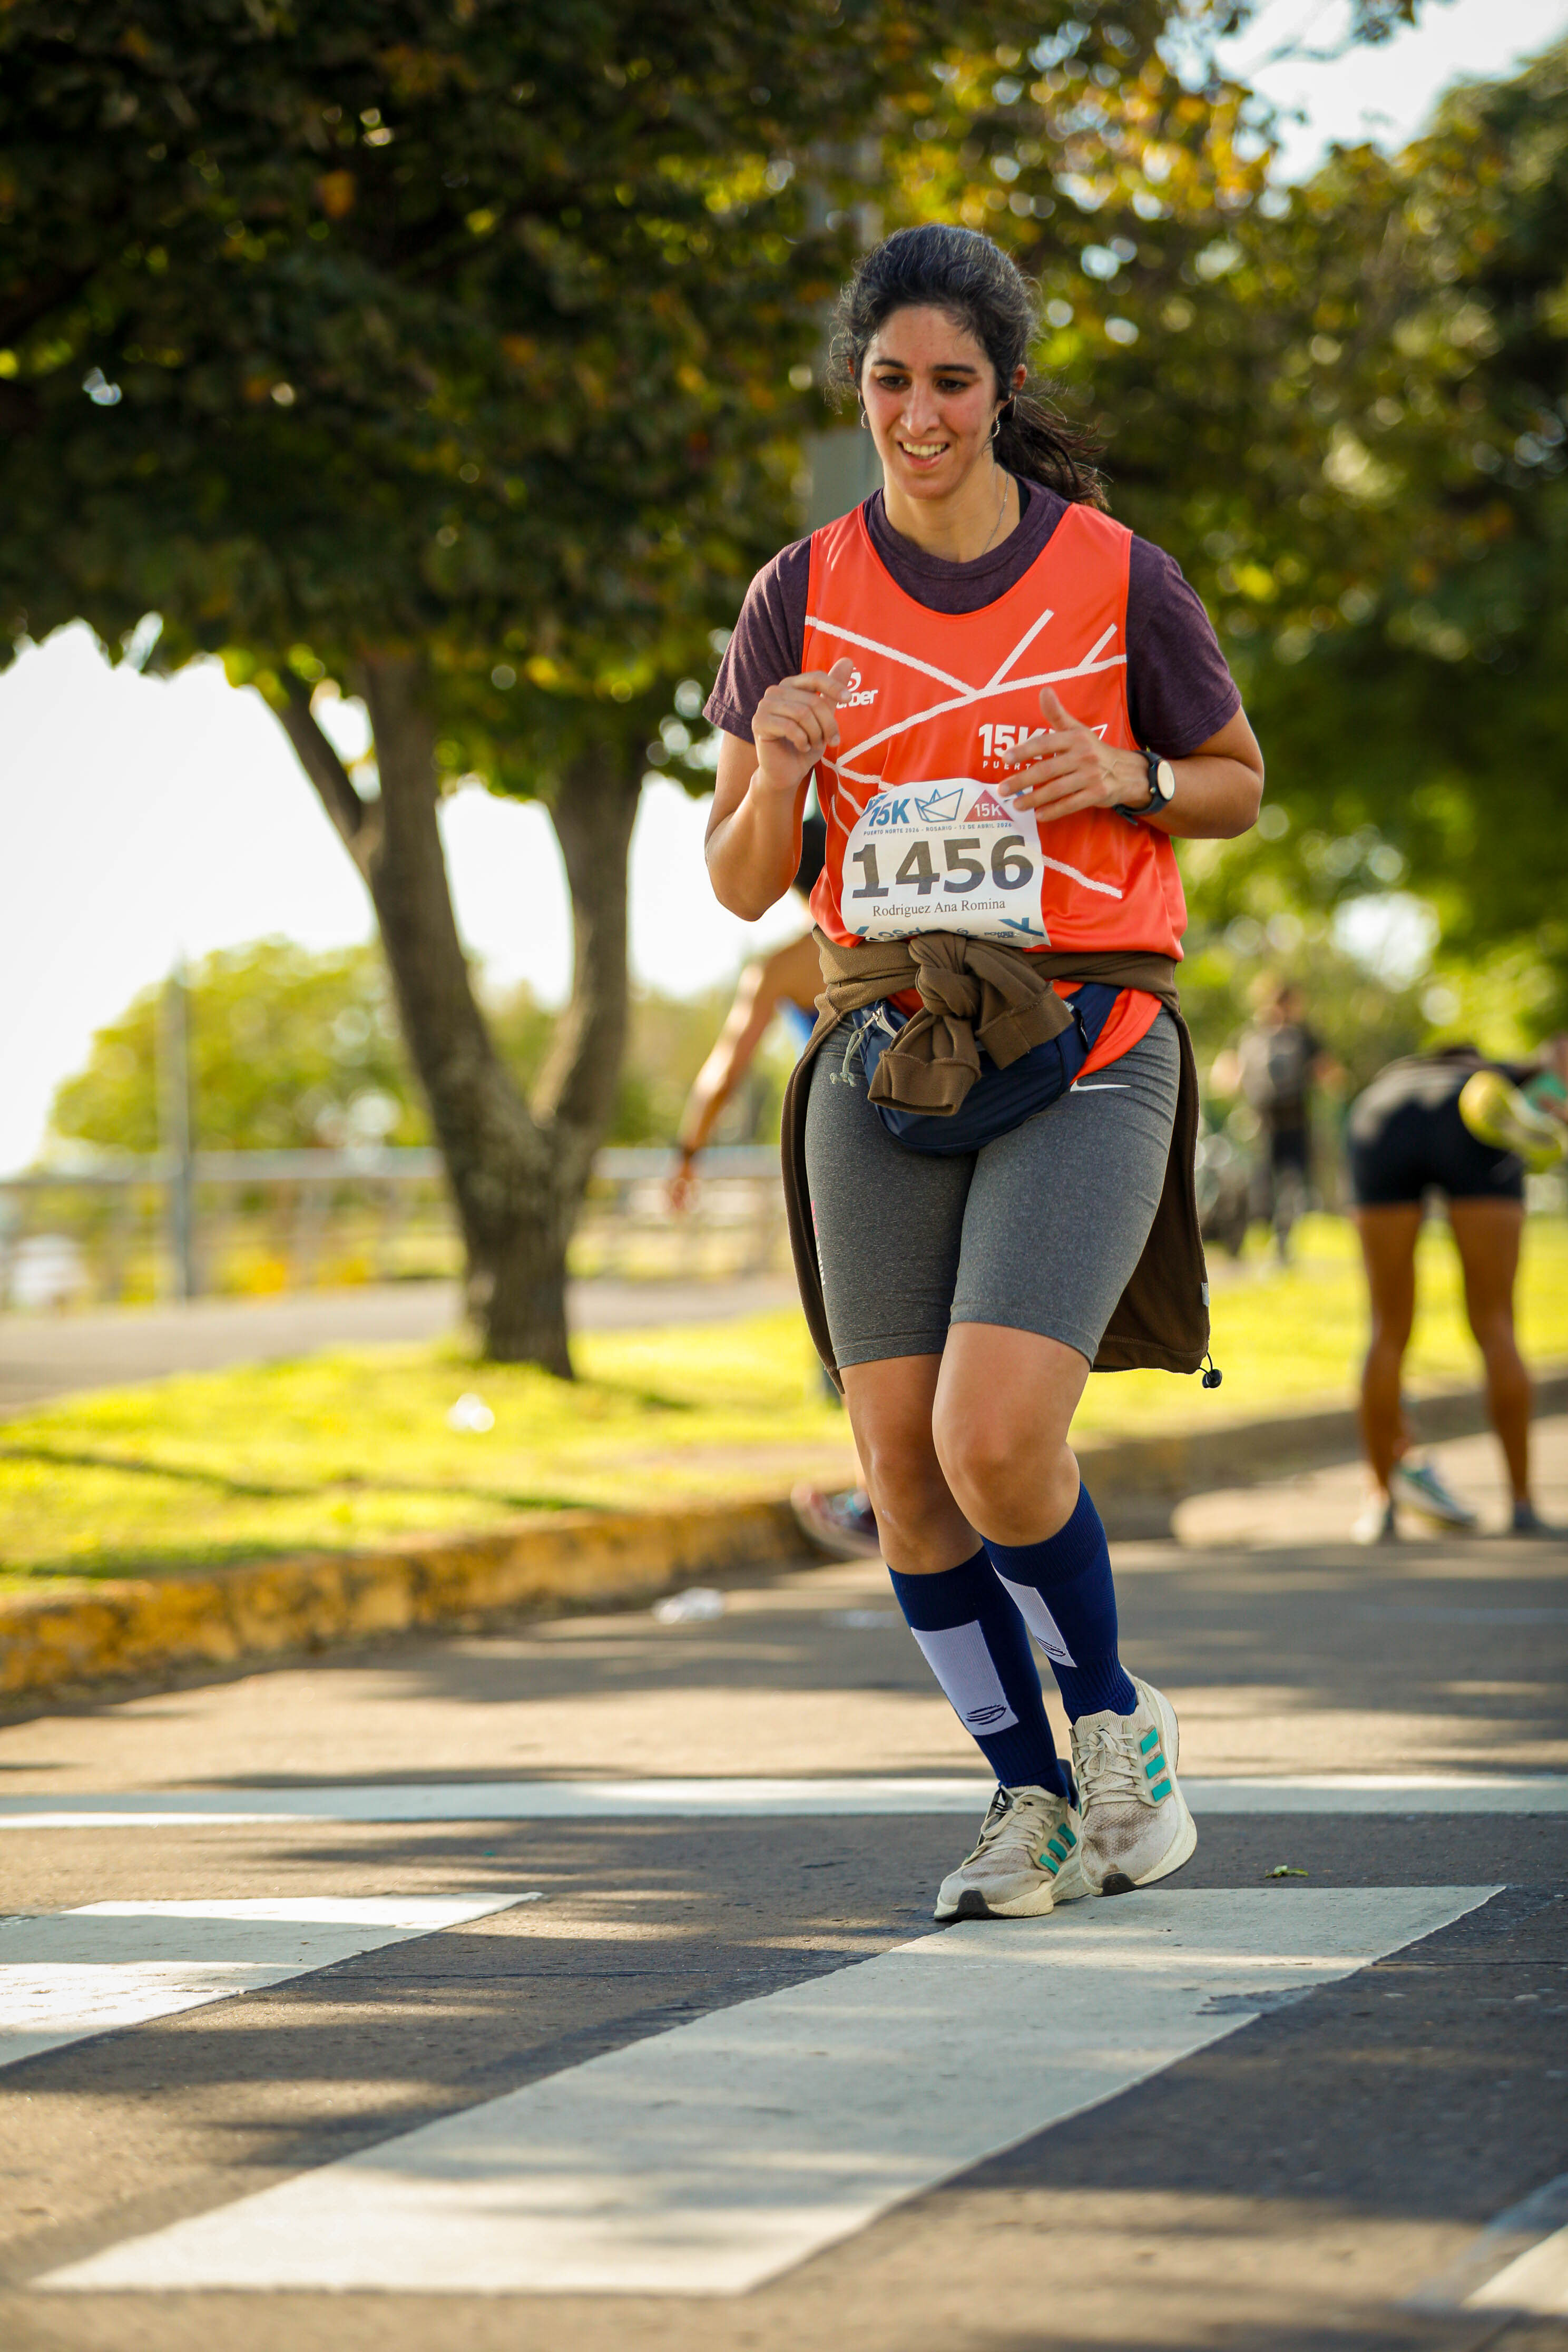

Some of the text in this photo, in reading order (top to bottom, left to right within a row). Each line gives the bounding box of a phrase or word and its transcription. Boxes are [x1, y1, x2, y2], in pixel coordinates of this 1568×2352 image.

[983, 760, 1031, 771] PUERT
[868, 798, 910, 827] 15K
[974, 803, 1002, 817] 15K
[852, 835, 1034, 898] 1456
[873, 898, 1006, 918] Rodriguez Ana Romina
